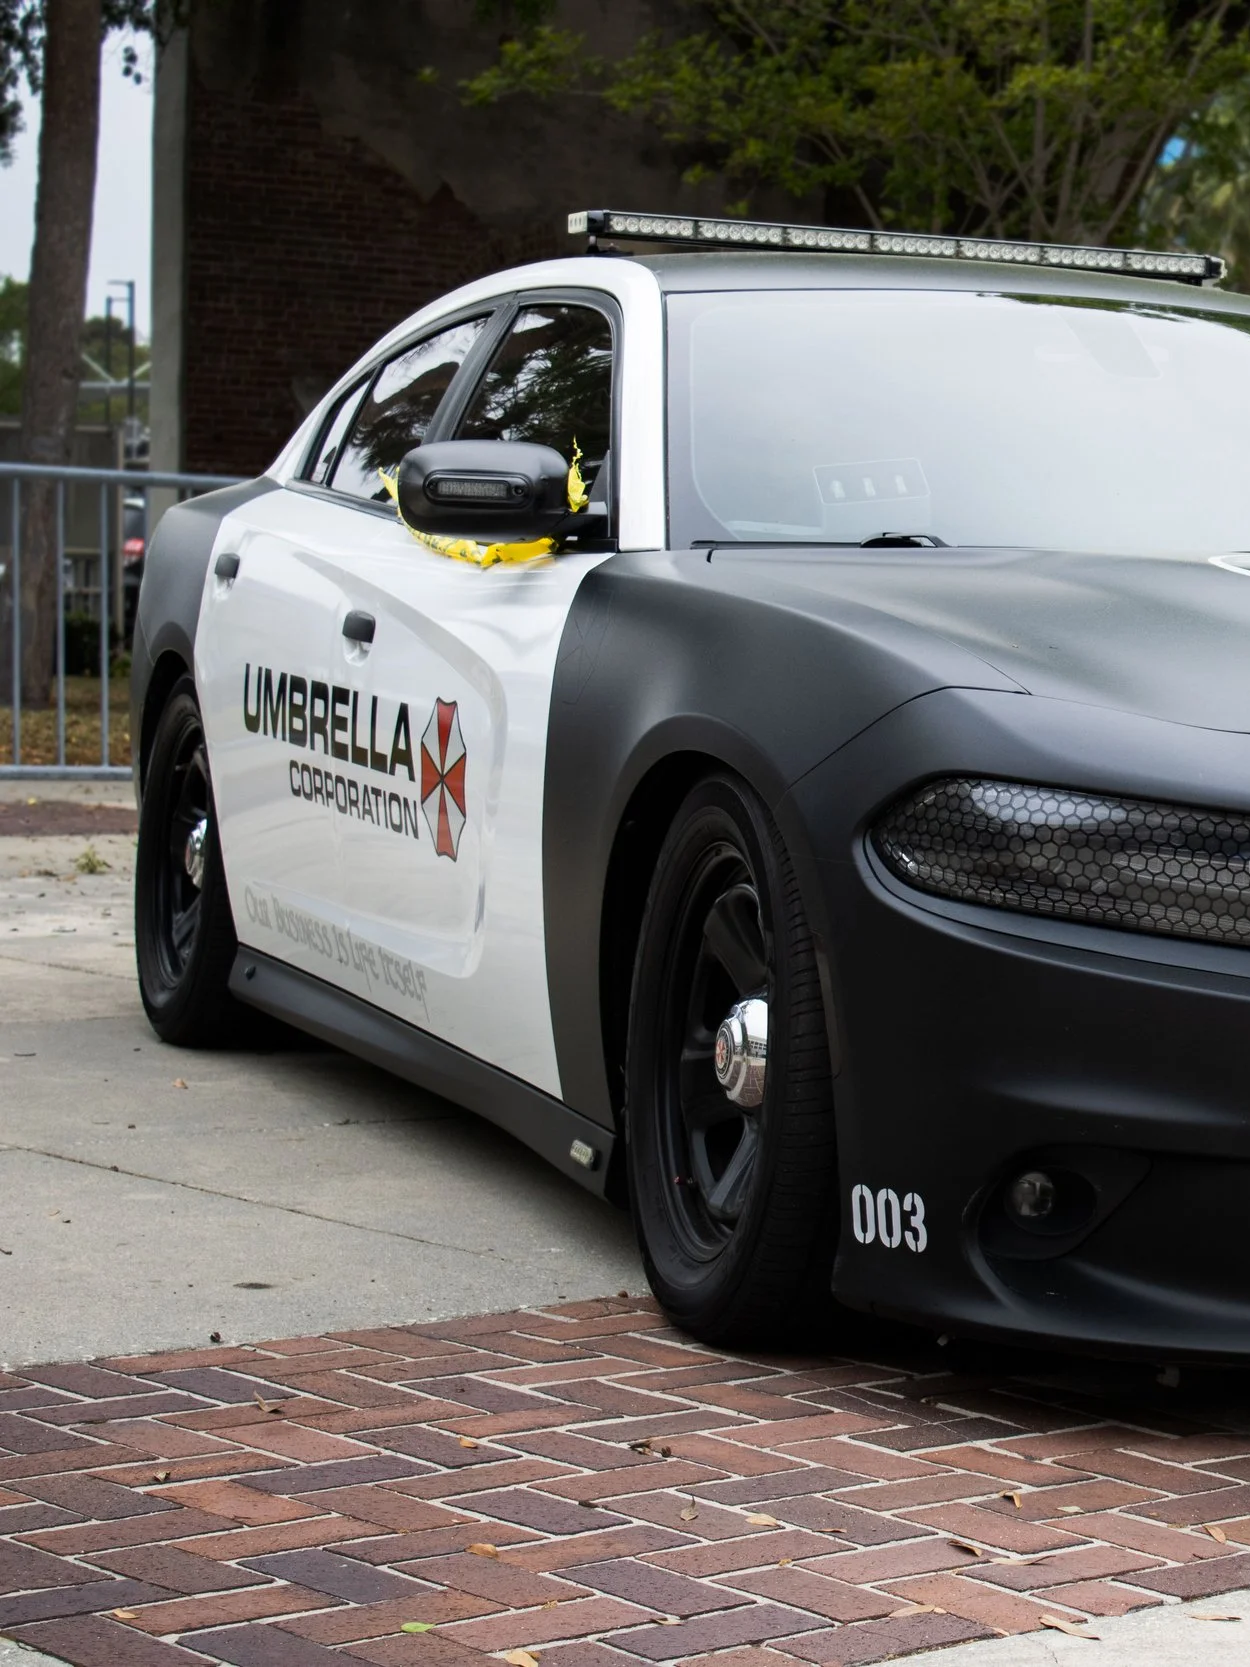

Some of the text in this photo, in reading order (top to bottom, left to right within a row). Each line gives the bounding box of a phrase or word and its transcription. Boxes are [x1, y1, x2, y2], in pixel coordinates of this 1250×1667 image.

[243, 662, 416, 783] UMBRELLA
[289, 759, 420, 840] CORPORATION
[851, 1183, 928, 1253] 003
